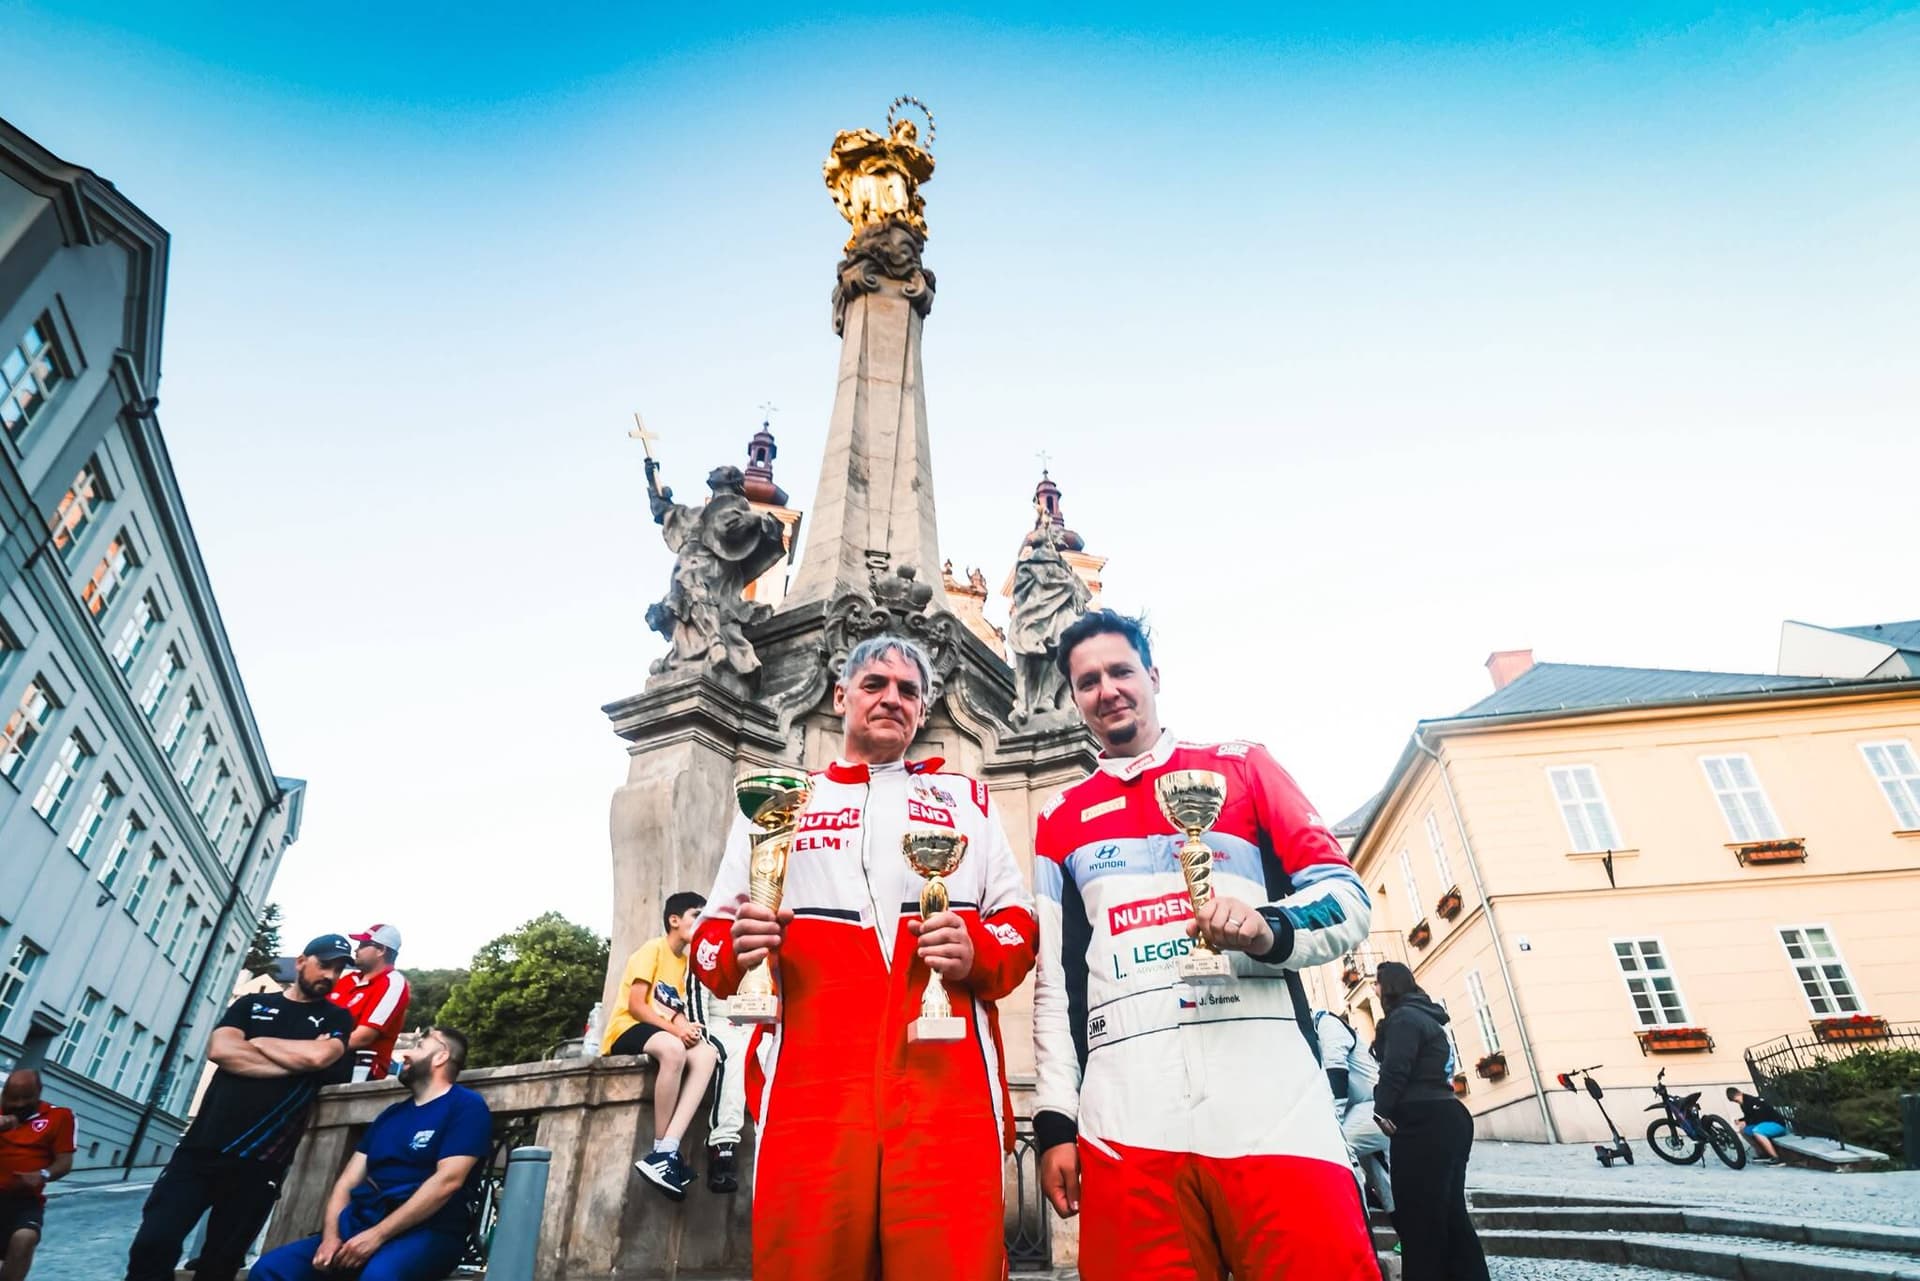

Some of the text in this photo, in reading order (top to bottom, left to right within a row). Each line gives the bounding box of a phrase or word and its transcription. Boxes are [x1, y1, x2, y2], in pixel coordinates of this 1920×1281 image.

[909, 802, 949, 822] END
[791, 836, 841, 852] ELM
[1089, 860, 1126, 871] HYUNDAI
[1113, 897, 1195, 929] NUTREN
